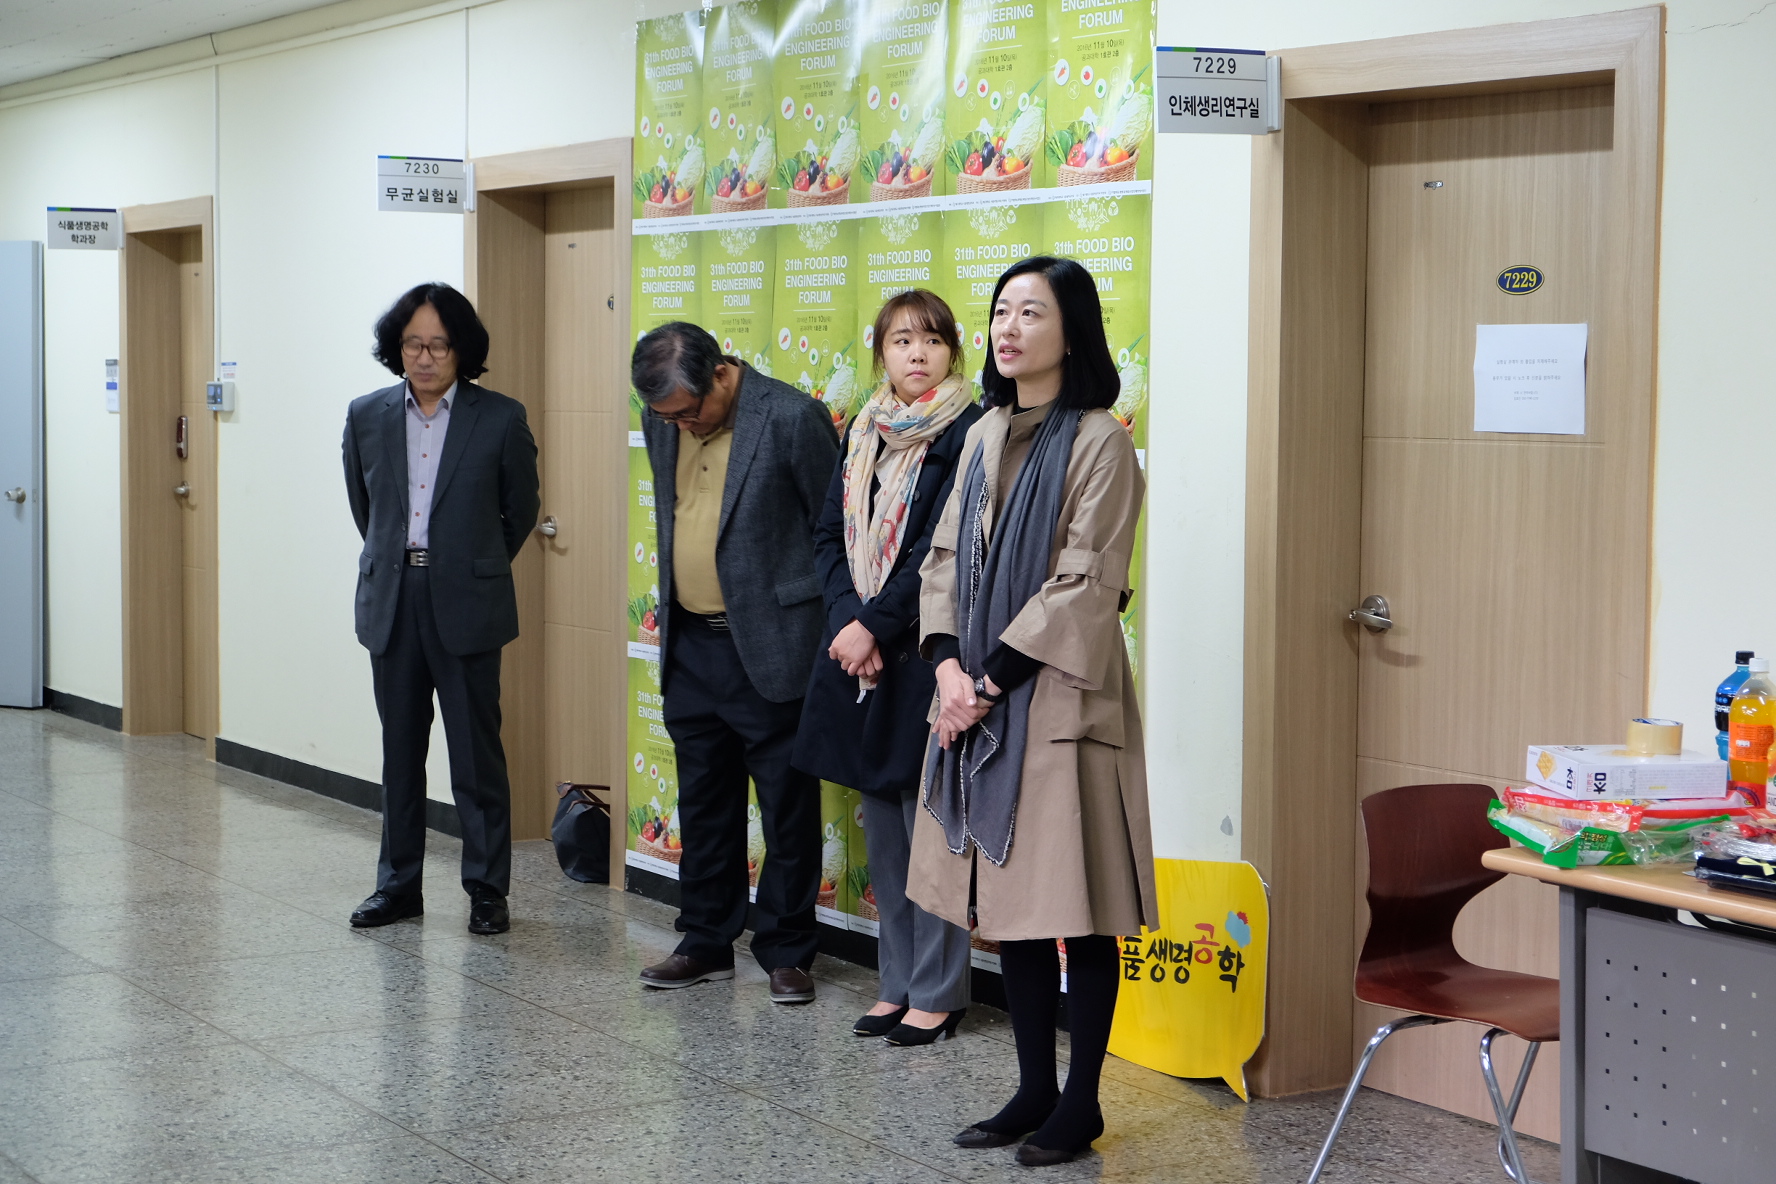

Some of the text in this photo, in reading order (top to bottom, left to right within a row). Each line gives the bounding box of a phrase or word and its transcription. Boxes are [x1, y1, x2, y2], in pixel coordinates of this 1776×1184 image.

[922, 1, 940, 17] BIO
[963, 3, 1034, 28] ENGINEERING
[805, 20, 832, 36] FOOD
[835, 17, 851, 31] BIO
[1079, 9, 1124, 29] FORUM
[872, 20, 938, 43] ENGINEERING
[977, 25, 1016, 44] FORUM
[730, 34, 749, 50] FOOD
[785, 35, 850, 57] ENGINEERING
[887, 41, 923, 59] FORUM
[645, 45, 694, 64] 31th FOOD BIO
[713, 48, 763, 69] ENGINEERING
[800, 54, 836, 71] FORUM
[645, 61, 693, 80] ENGINEERING
[1193, 57, 1237, 74] 7229
[726, 66, 752, 83] FORUM
[656, 78, 684, 93] FORUM
[1169, 95, 1260, 119] 인체생리연구실
[404, 162, 440, 174] 7230
[385, 187, 458, 204] 무균실험실
[57, 220, 109, 231] 식품생명공학
[71, 234, 96, 245] 학과장
[1054, 236, 1135, 256] 31th FOOD BIO
[867, 249, 932, 267] 31th FOOD BIO
[954, 243, 1031, 262] 31th FOOD BIO
[641, 264, 696, 278] 31th FOOD BIO
[710, 260, 765, 276] 31th FOOD BIO
[784, 255, 848, 272] 31th FOOD BIO
[785, 272, 846, 288] ENGINEERING
[868, 266, 931, 284] ENGINEERING
[1504, 271, 1537, 289] 7229
[641, 280, 695, 293] ENGINEERING
[711, 277, 763, 292] ENGINEERING
[652, 296, 683, 309] FORUM
[723, 294, 751, 307] FORUM
[798, 290, 832, 304] FORUM
[637, 479, 653, 492] 31th
[637, 690, 652, 704] 31th
[1116, 922, 1246, 994] 품생명공학
